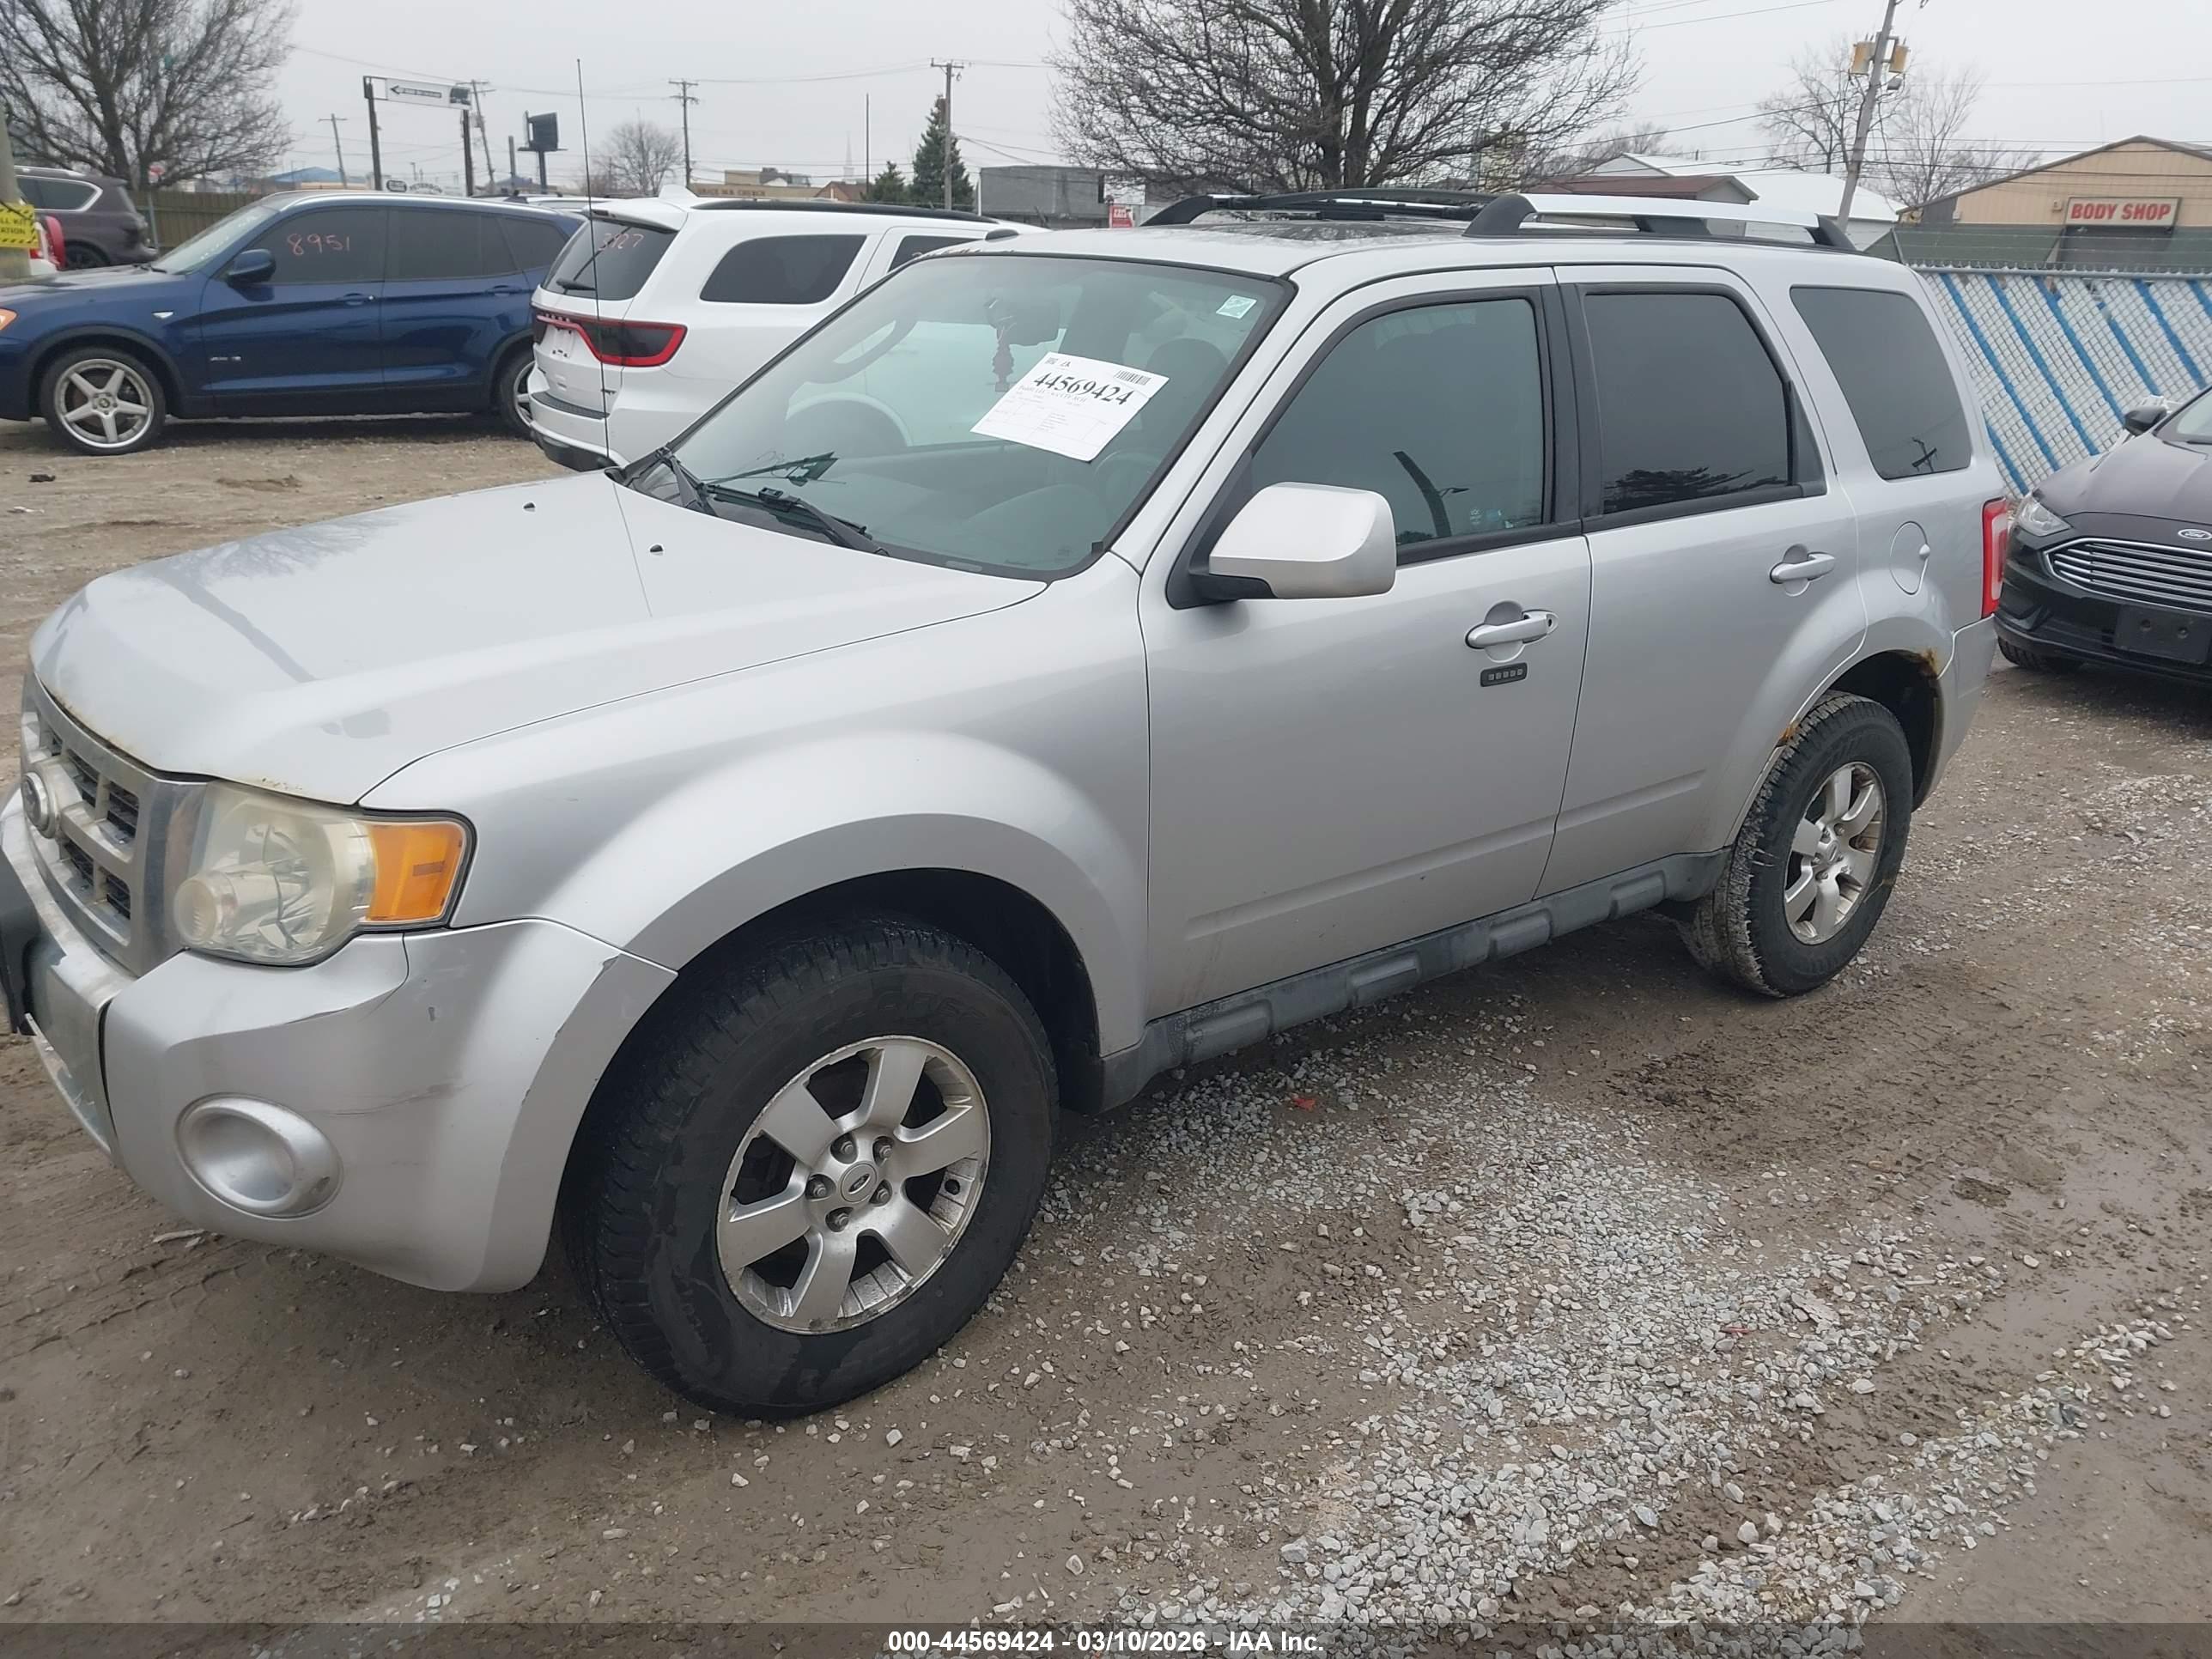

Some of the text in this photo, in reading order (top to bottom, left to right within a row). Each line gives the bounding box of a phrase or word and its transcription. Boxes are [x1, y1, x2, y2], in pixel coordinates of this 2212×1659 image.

[2070, 203, 2172, 221] BODY SHOP
[287, 233, 350, 255] 8951
[1033, 372, 1134, 405] 44569424
